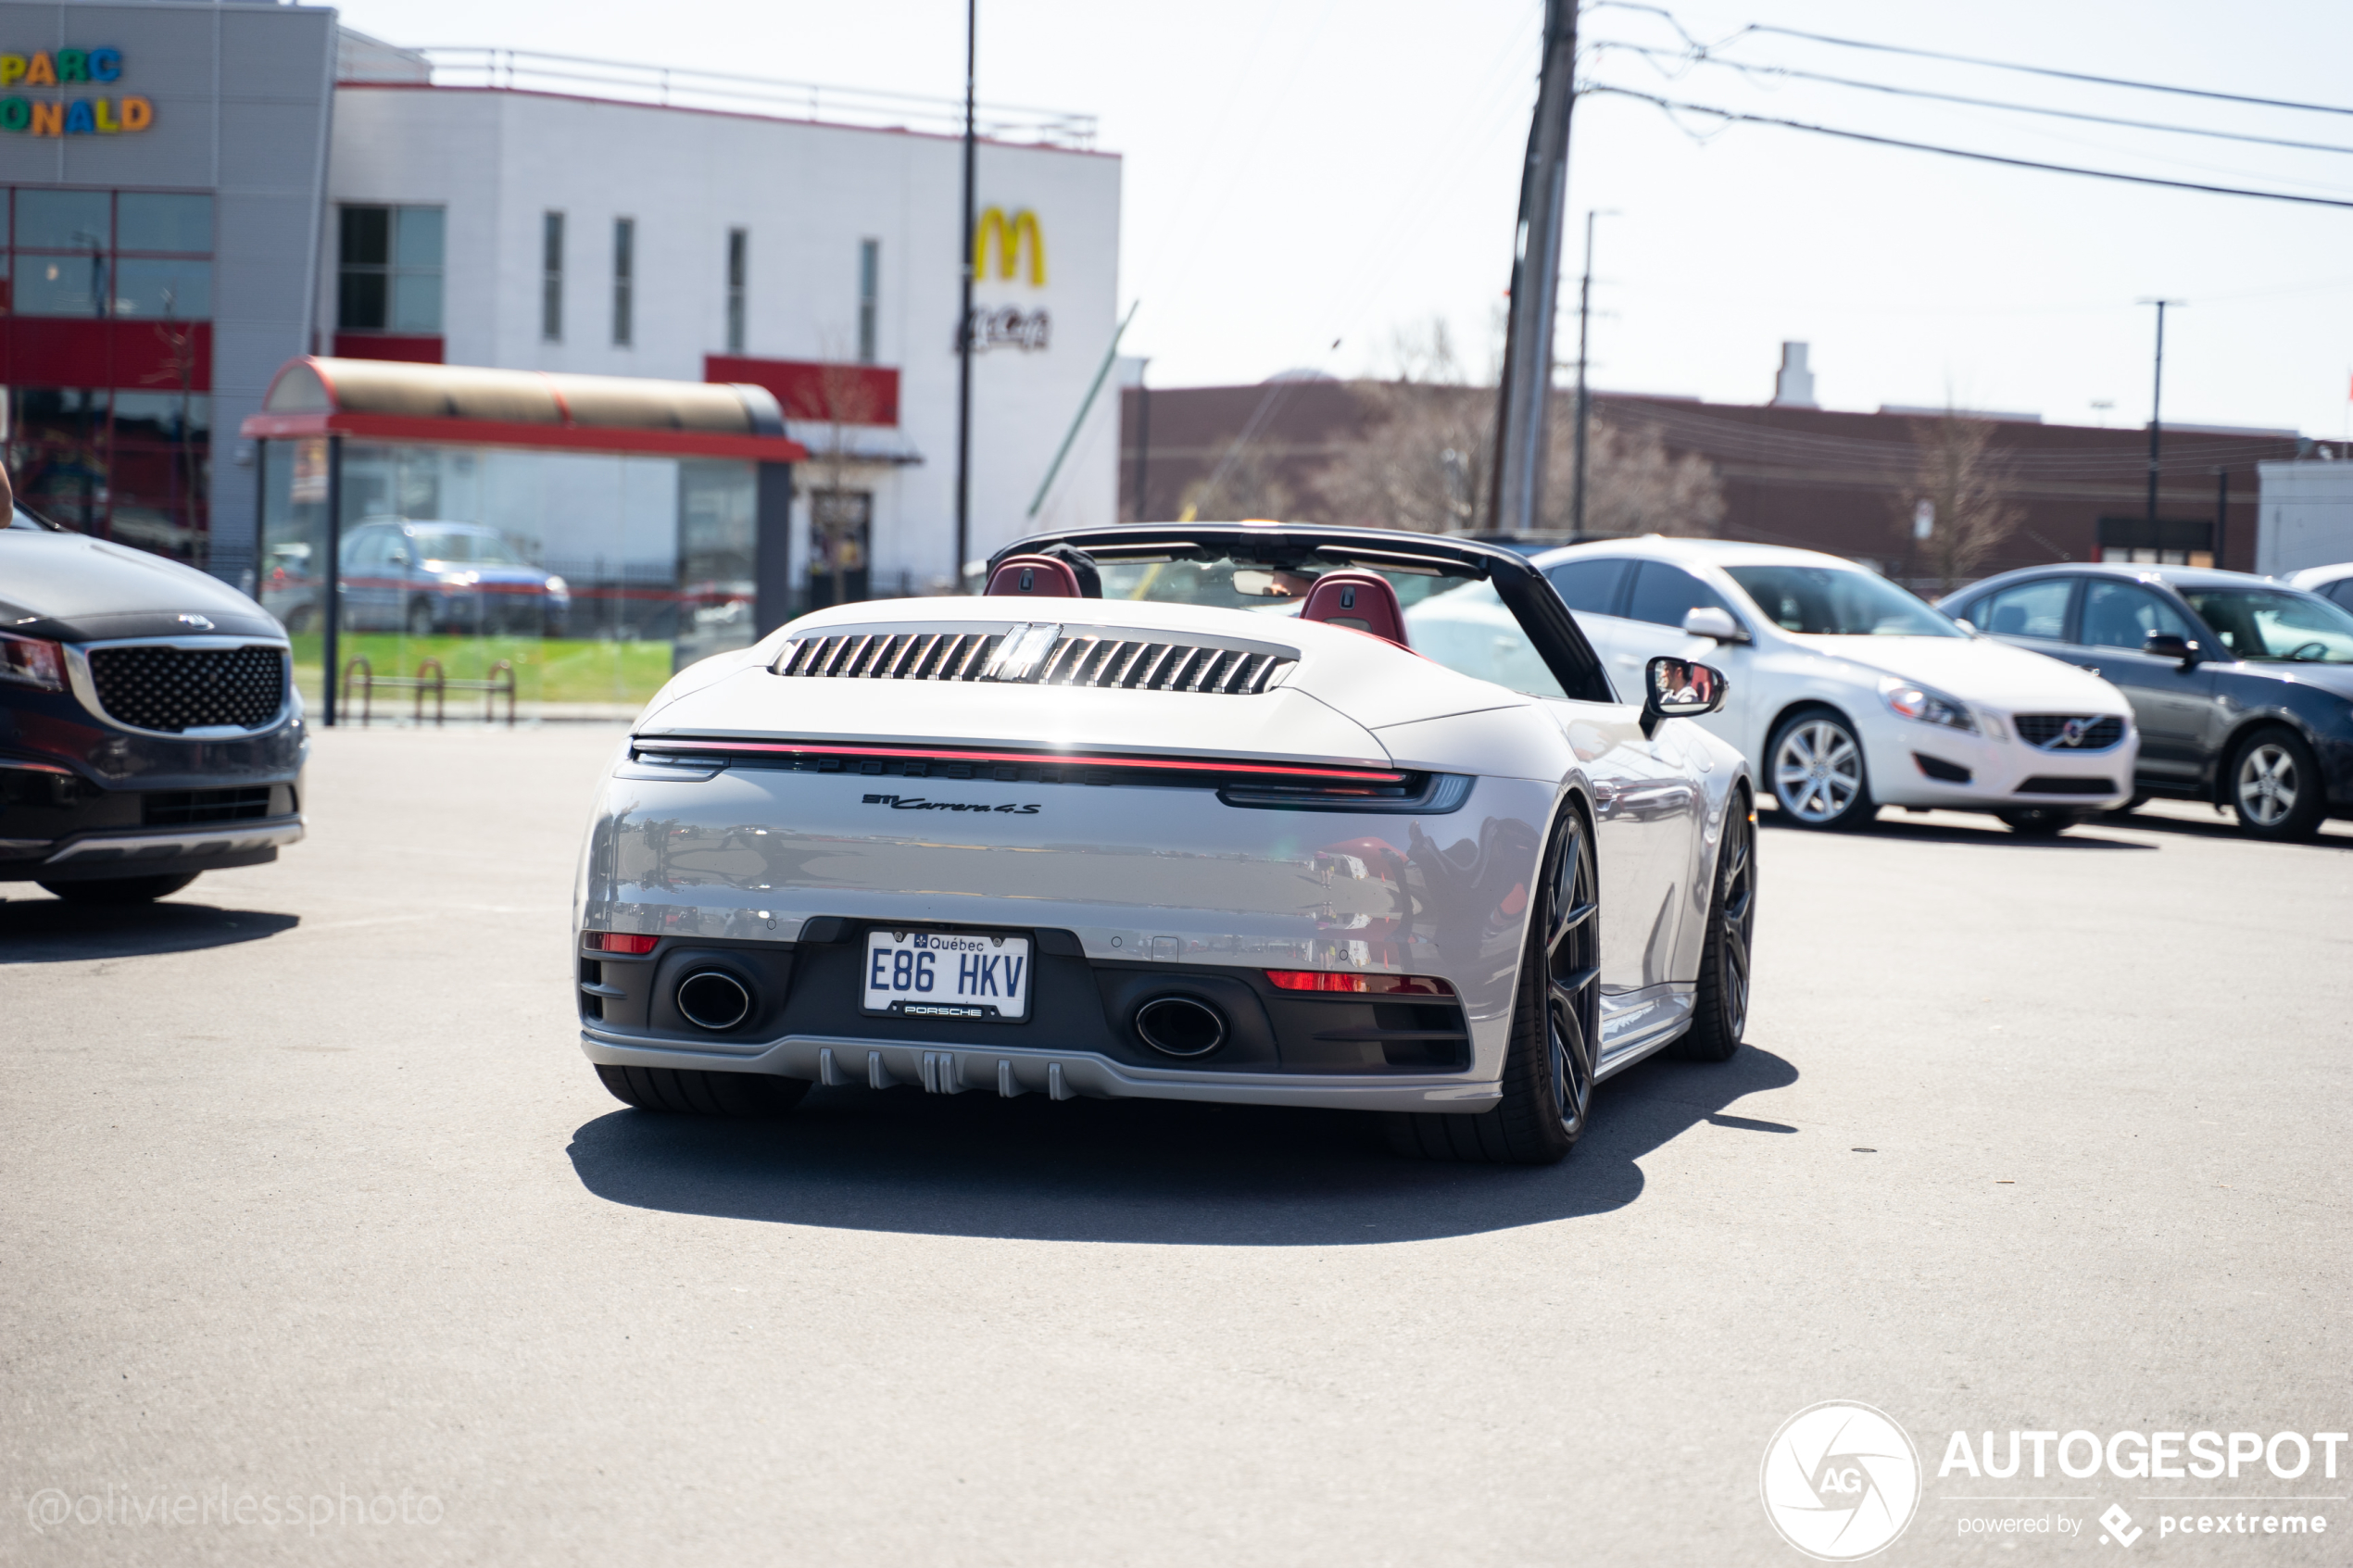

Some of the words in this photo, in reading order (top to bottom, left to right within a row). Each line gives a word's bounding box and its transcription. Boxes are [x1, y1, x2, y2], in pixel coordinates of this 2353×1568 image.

[0, 47, 122, 86] PARC
[817, 757, 1112, 786] PORSCHE
[890, 797, 991, 812] Carrera
[929, 937, 984, 951] Québec
[870, 947, 936, 992] E86
[958, 953, 1024, 997] HKV
[904, 1006, 982, 1017] PORSCHE
[1534, 1010, 1545, 1076] MICHELIN
